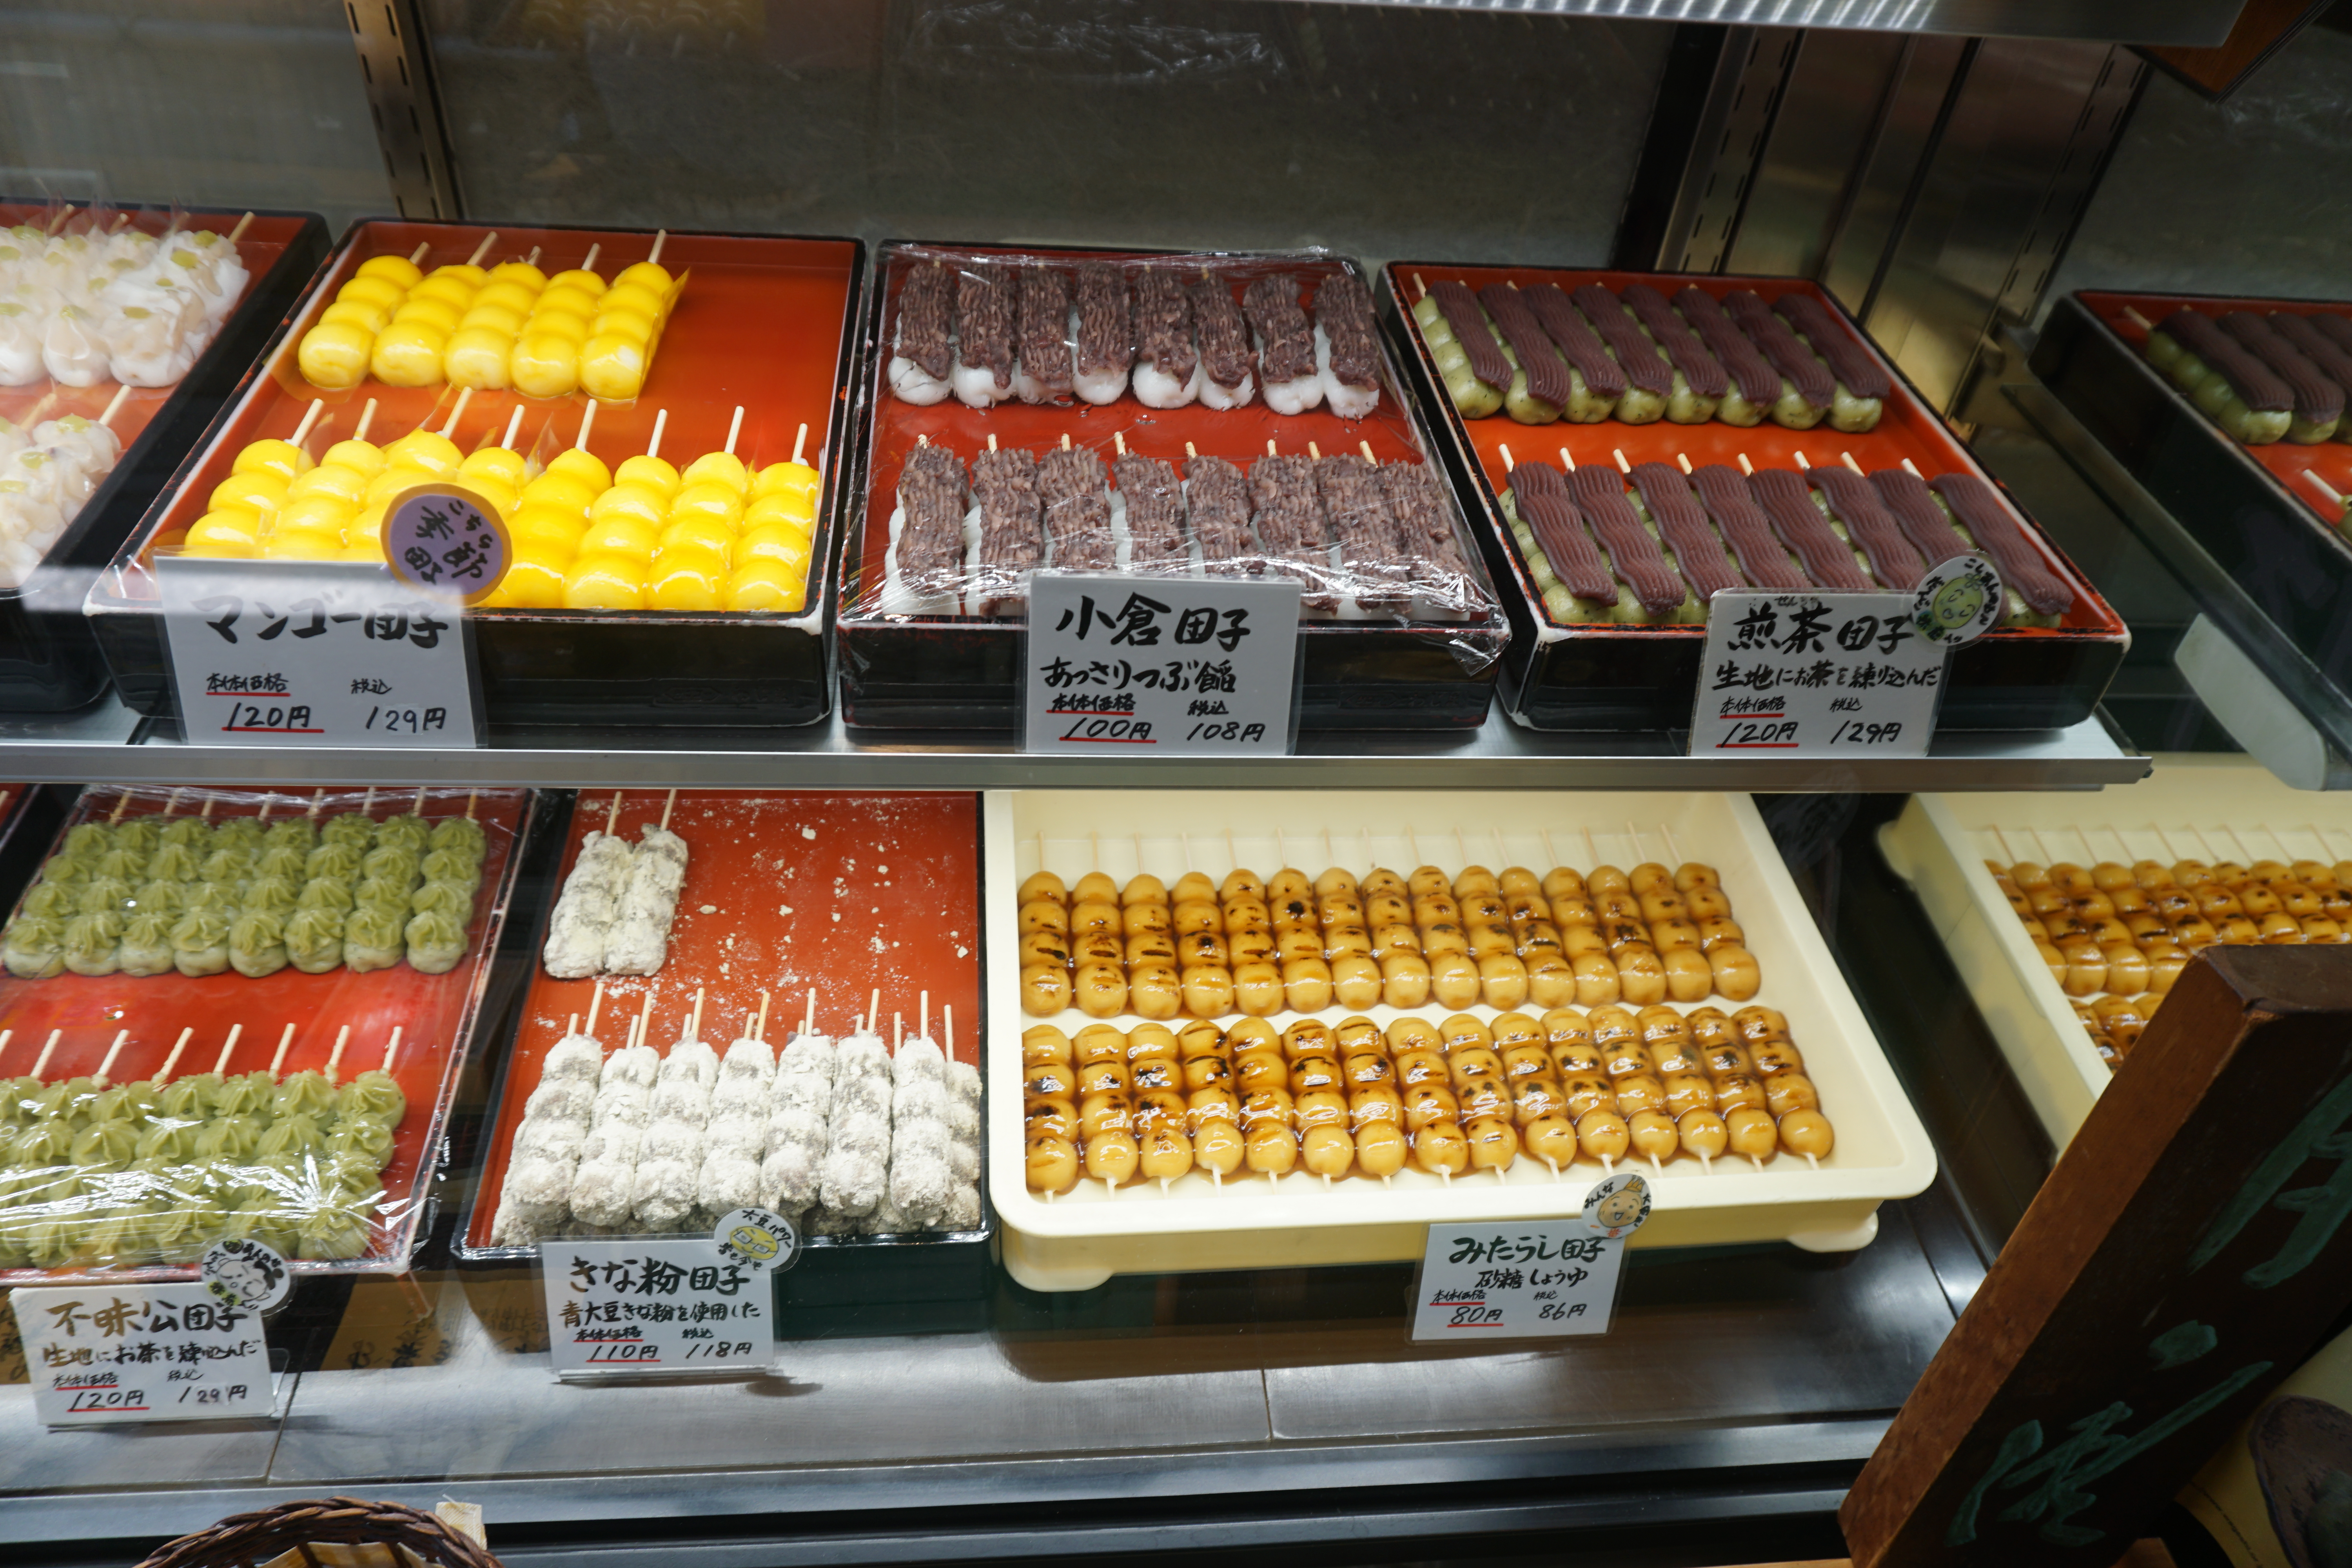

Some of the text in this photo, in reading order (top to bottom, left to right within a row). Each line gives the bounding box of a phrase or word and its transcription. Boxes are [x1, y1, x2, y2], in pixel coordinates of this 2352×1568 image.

[190, 589, 448, 648] マンゴー団子
[1056, 592, 1250, 652] 小倉団子
[1727, 601, 1915, 655] 煎茶団子
[207, 673, 288, 692] 本体価格
[1712, 659, 1942, 692] 生地にお茶を練り込んだ
[351, 679, 391, 694] 税込
[1052, 693, 1136, 712] 本体価格
[1187, 700, 1229, 715] 税込
[1720, 695, 1786, 714] 本体価格
[1830, 697, 1862, 712] 税込
[228, 702, 310, 730] 120円
[366, 707, 446, 733] 129円
[1065, 717, 1152, 740] 100円
[1187, 722, 1266, 742] 108円
[1721, 722, 1798, 748] 120円
[1831, 720, 1902, 744] 129円
[1584, 1181, 1613, 1209] みんな
[742, 1210, 791, 1248] 大豆パワー
[1449, 1235, 1606, 1264] みたらし団子
[570, 1256, 750, 1296] きな粉団子
[1432, 1290, 1487, 1304] 本体価格
[1534, 1291, 1558, 1301] 税込
[47, 1297, 247, 1337] 不味公団子
[558, 1300, 760, 1328] 青大豆きな粉を使用した
[1451, 1307, 1503, 1323] 80円
[1539, 1303, 1587, 1320] 86円
[576, 1326, 643, 1341] 本体価格
[682, 1329, 713, 1339] 税込
[42, 1339, 260, 1367] 生地にお茶を練り込んだ
[590, 1345, 658, 1361] 110円
[686, 1343, 752, 1359] 118円
[53, 1373, 118, 1388] 本体価格
[167, 1369, 204, 1382] 税込
[70, 1390, 143, 1411] 120円
[179, 1385, 247, 1403] 129円
